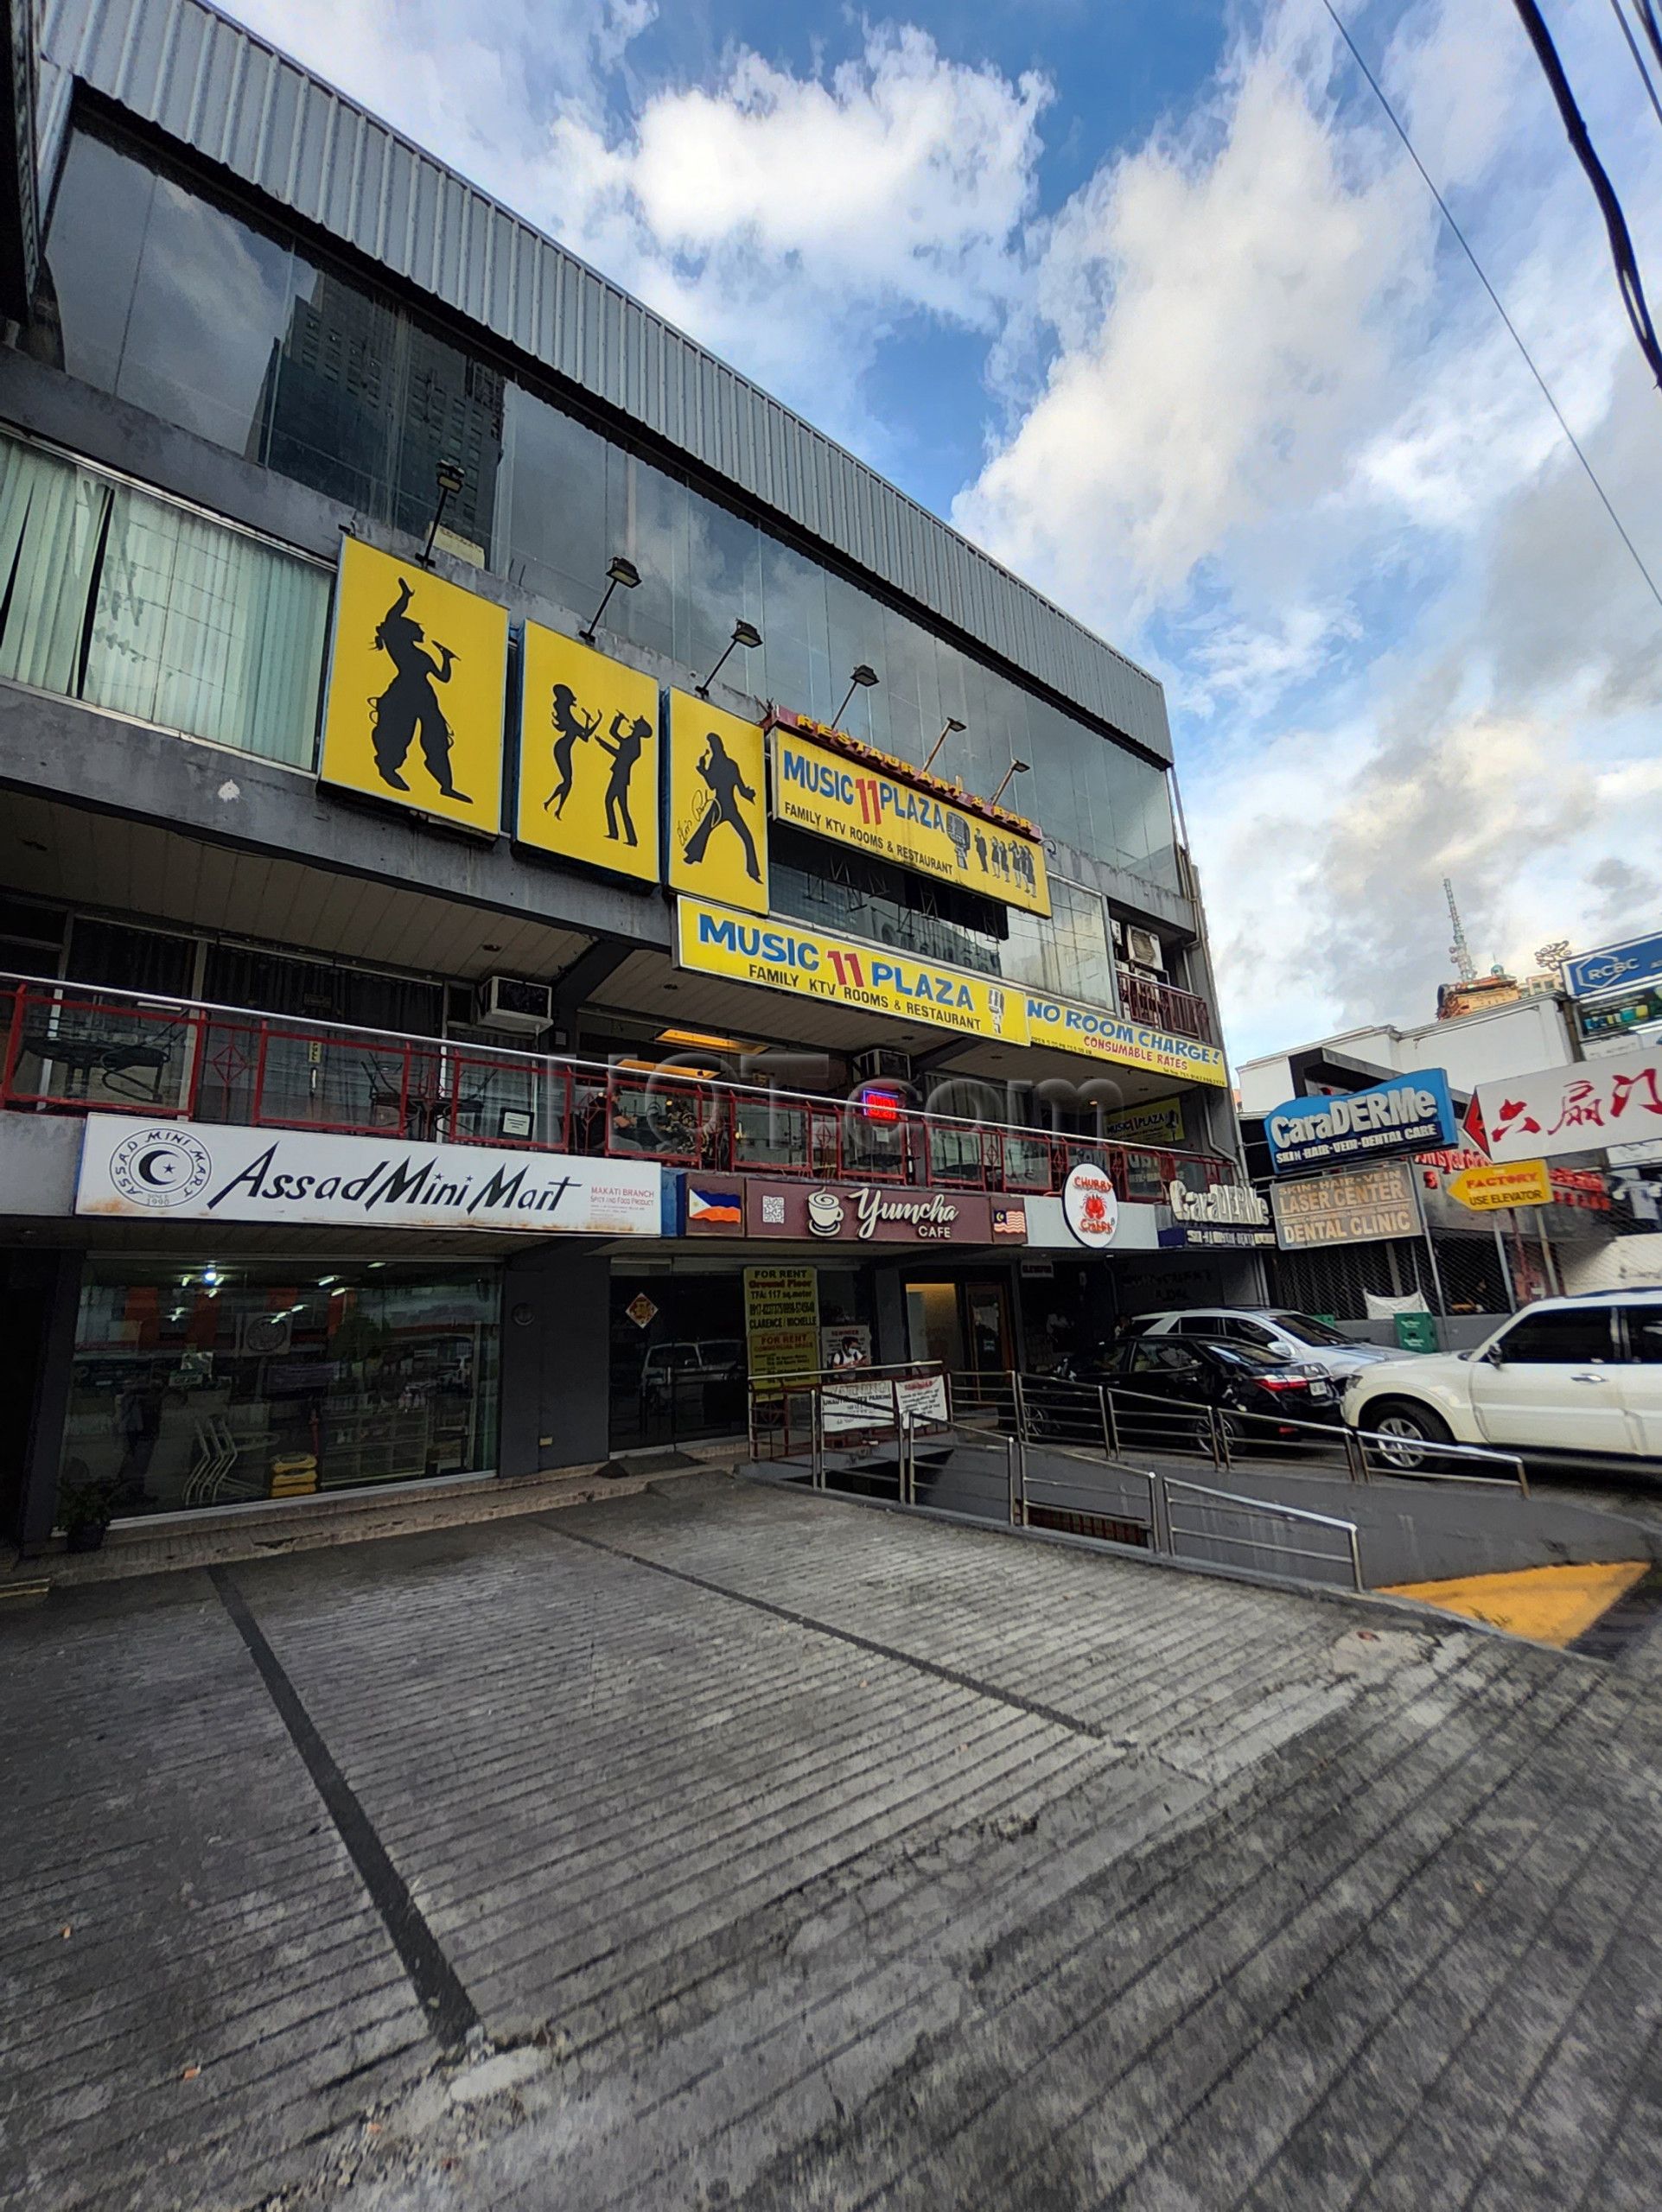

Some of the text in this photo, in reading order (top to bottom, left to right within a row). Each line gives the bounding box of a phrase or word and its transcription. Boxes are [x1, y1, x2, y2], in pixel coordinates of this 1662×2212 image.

[797, 715, 964, 797] RESTAURANT
[992, 806, 1034, 830] BAR
[783, 750, 946, 835] MUSIC 11 PLAZA
[785, 803, 953, 875] FAMILY KTV ROOMS & RESTAURANT
[699, 913, 974, 1011] MUSIC 11 PLAZA
[1588, 958, 1640, 981] RCBC
[748, 963, 982, 1031] FAMILY KTV ROOMS & RESTAURANT
[1027, 999, 1220, 1065] NO ROOM CHARGE!
[1084, 1036, 1188, 1071] CONSUMABLE RATES
[1138, 1113, 1164, 1127] PLAZA
[1270, 1087, 1438, 1149] CaraDERMe
[1404, 1124, 1437, 1140] CARE
[115, 1131, 207, 1198] ASSAD MINI MART
[207, 1141, 583, 1215] Assad Mini Mart
[1467, 1172, 1539, 1188] FACTORY
[591, 1186, 654, 1198] MAKATI BRANCH
[1280, 1190, 1331, 1214] LASER
[1334, 1180, 1405, 1206] CENTER
[1469, 1195, 1488, 1206] USE
[1492, 1189, 1543, 1204] ELEVATOR
[847, 1187, 960, 1239] Yumcha
[1284, 1217, 1347, 1243] DENTAL
[1350, 1211, 1411, 1236] CLINIC
[918, 1225, 951, 1238] CAFE
[755, 1270, 807, 1279] FOR RENT
[761, 1334, 807, 1345] FOR RENT
